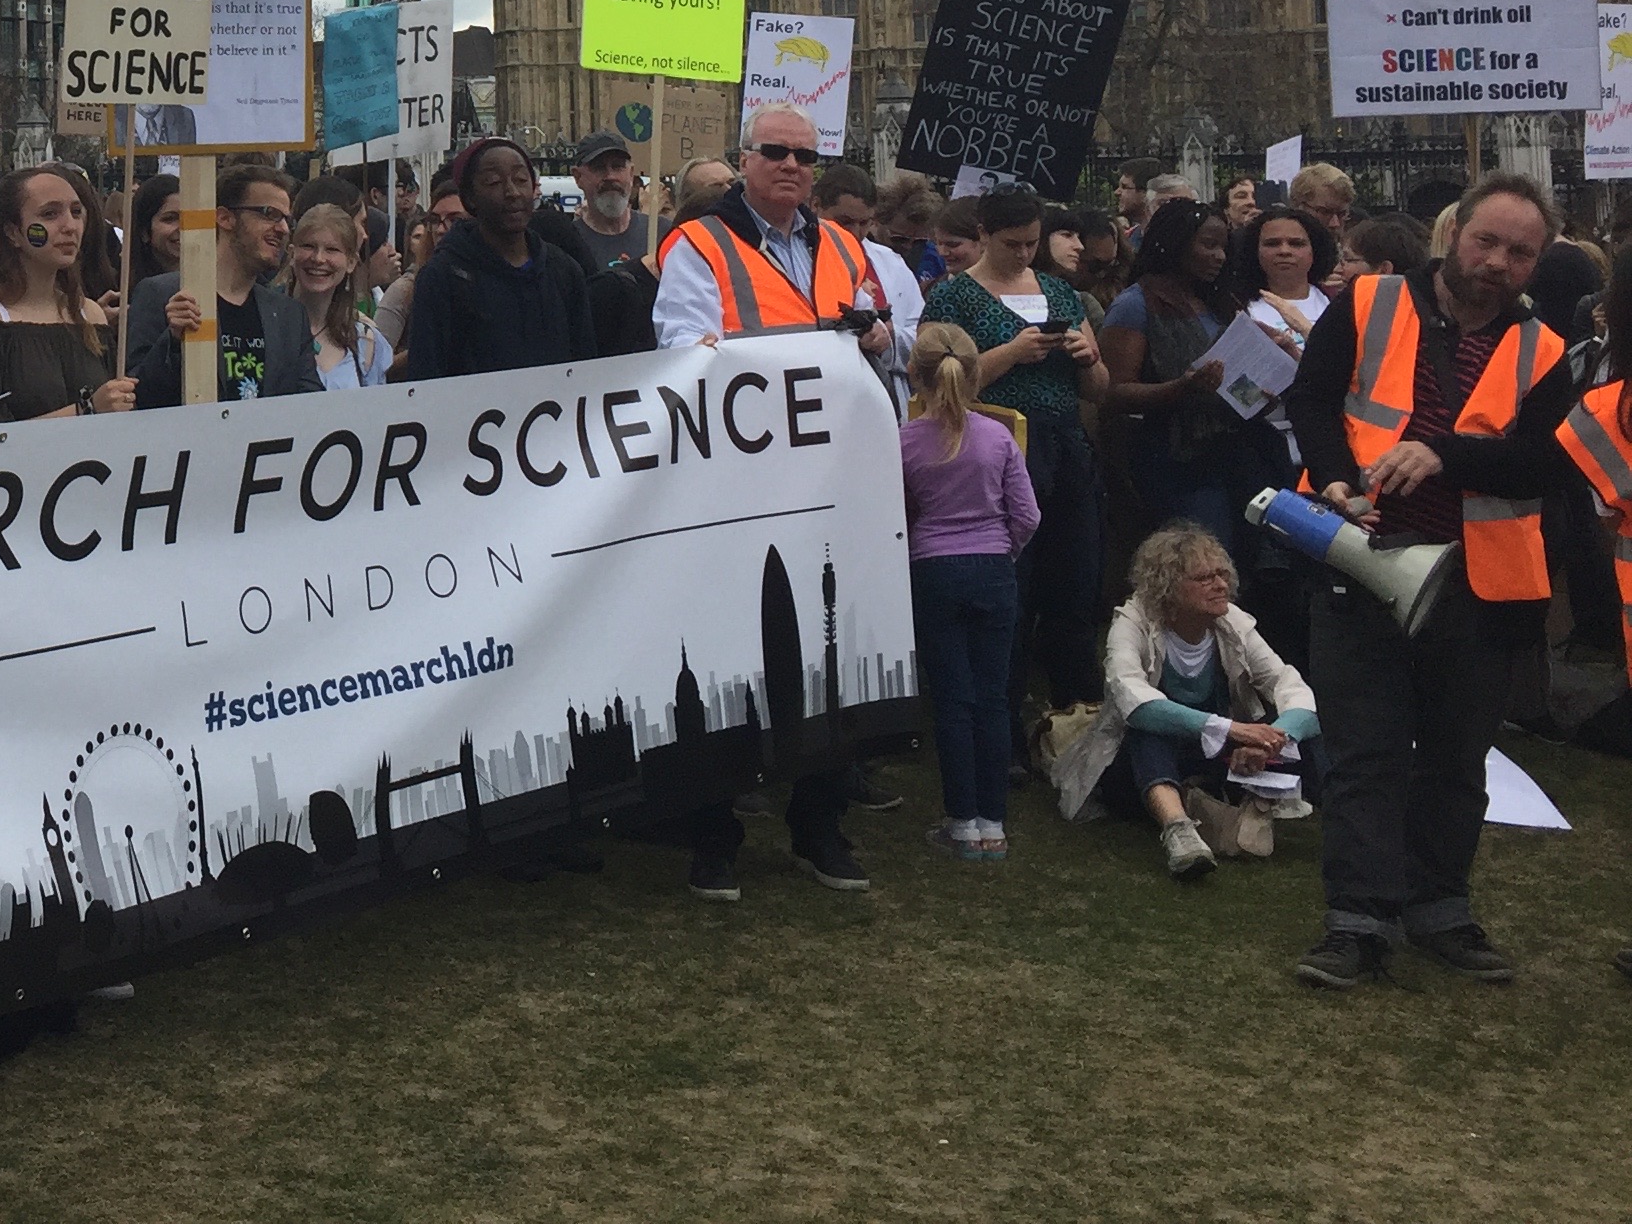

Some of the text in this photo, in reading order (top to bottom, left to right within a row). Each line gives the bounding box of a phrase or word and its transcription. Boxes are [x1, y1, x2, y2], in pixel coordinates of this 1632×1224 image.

[109, 6, 173, 38] FOR
[225, 1, 250, 14] that
[254, 1, 274, 14] it's
[276, 3, 303, 15] true
[1401, 4, 1533, 27] Can't drink oil
[1598, 12, 1628, 29] ake?
[260, 25, 274, 36] or
[276, 25, 298, 36] not
[755, 18, 805, 35] Fake?
[971, 0, 1099, 55] SCIENCE
[217, 43, 275, 57] believe in
[397, 24, 439, 66] CTS
[594, 48, 648, 69] Science,
[652, 55, 675, 69] not
[935, 26, 1077, 77] IS THAT IT'S
[66, 48, 206, 96] SCIENCE
[1382, 47, 1539, 74] SCIENCE for a
[750, 73, 792, 89] Real.
[968, 58, 1047, 95] TRUE
[922, 76, 1096, 127] WHETHER OR NOT
[1355, 79, 1569, 104] sustainable society
[66, 109, 102, 123] HERE
[402, 93, 445, 128] TER
[661, 113, 722, 135] PLANET
[946, 101, 1050, 144] YOU'RE A
[680, 136, 694, 160] B
[910, 117, 1057, 186] NOBBER
[232, 419, 429, 534] FOR
[462, 364, 832, 498] SCIENCE
[181, 542, 524, 648] LONDON
[204, 634, 516, 733] #sciencemarchldn
